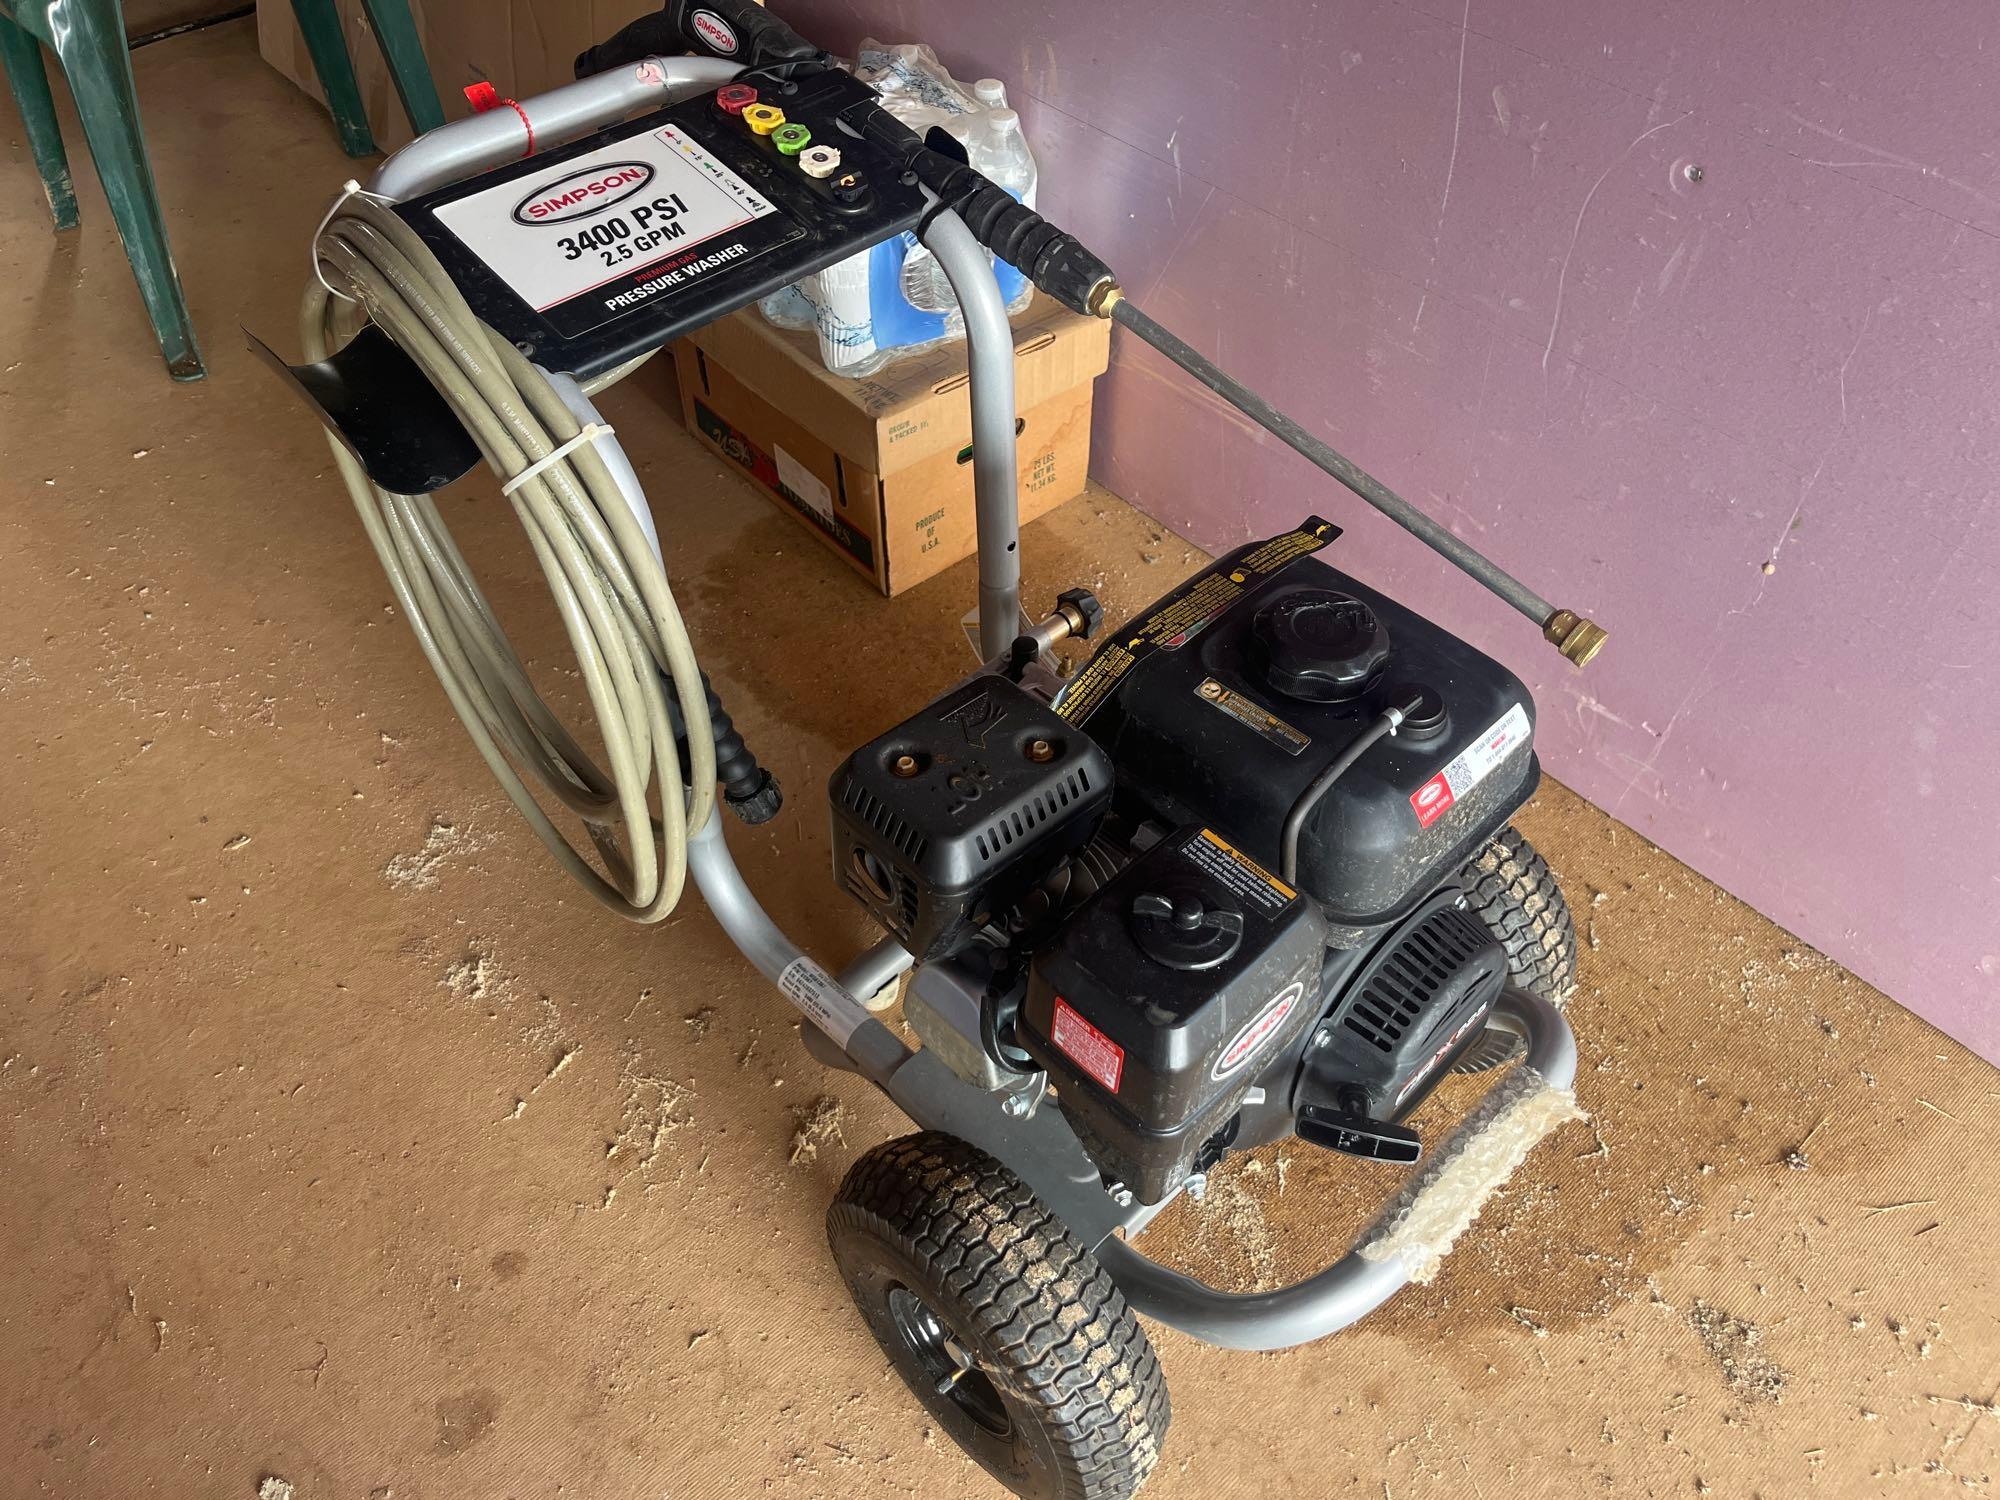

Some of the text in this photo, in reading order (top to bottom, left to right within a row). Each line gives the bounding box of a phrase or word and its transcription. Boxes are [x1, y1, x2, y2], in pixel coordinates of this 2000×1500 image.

[696, 17, 734, 48] SIMPSON
[528, 168, 643, 218] SIMPSON
[557, 193, 689, 260] 3400 PSI
[600, 221, 686, 267] 2.5 GPM
[604, 243, 749, 311] PRESSURE WASHER
[634, 252, 698, 284] PREMIUM GAS
[915, 507, 945, 531] PRODUCE
[927, 526, 935, 537] OF
[1473, 740, 1486, 754] SCAN
[1490, 726, 1501, 740] CODE
[1505, 713, 1516, 726] TEXT
[1421, 793, 1450, 822] LEARN MORE
[1186, 843, 1198, 852] This
[1195, 850, 1212, 863] engine
[1209, 860, 1224, 872] emits
[1221, 869, 1235, 880] toxic
[1233, 878, 1251, 892] carbon
[1187, 852, 1197, 860] not
[1213, 871, 1234, 888] enclosed
[1232, 886, 1245, 896] area.
[1191, 838, 1203, 848] Turn
[1200, 846, 1217, 859] engine
[1221, 861, 1232, 869] and
[1236, 872, 1248, 882] cool
[1246, 879, 1263, 892] before
[1196, 834, 1217, 850] Gasoline
[1219, 852, 1236, 865] highly
[1234, 862, 1258, 880] flammable
[1256, 877, 1267, 887] and
[1235, 853, 1272, 881] WARNING
[1227, 1000, 1290, 1063] SIMPSON
